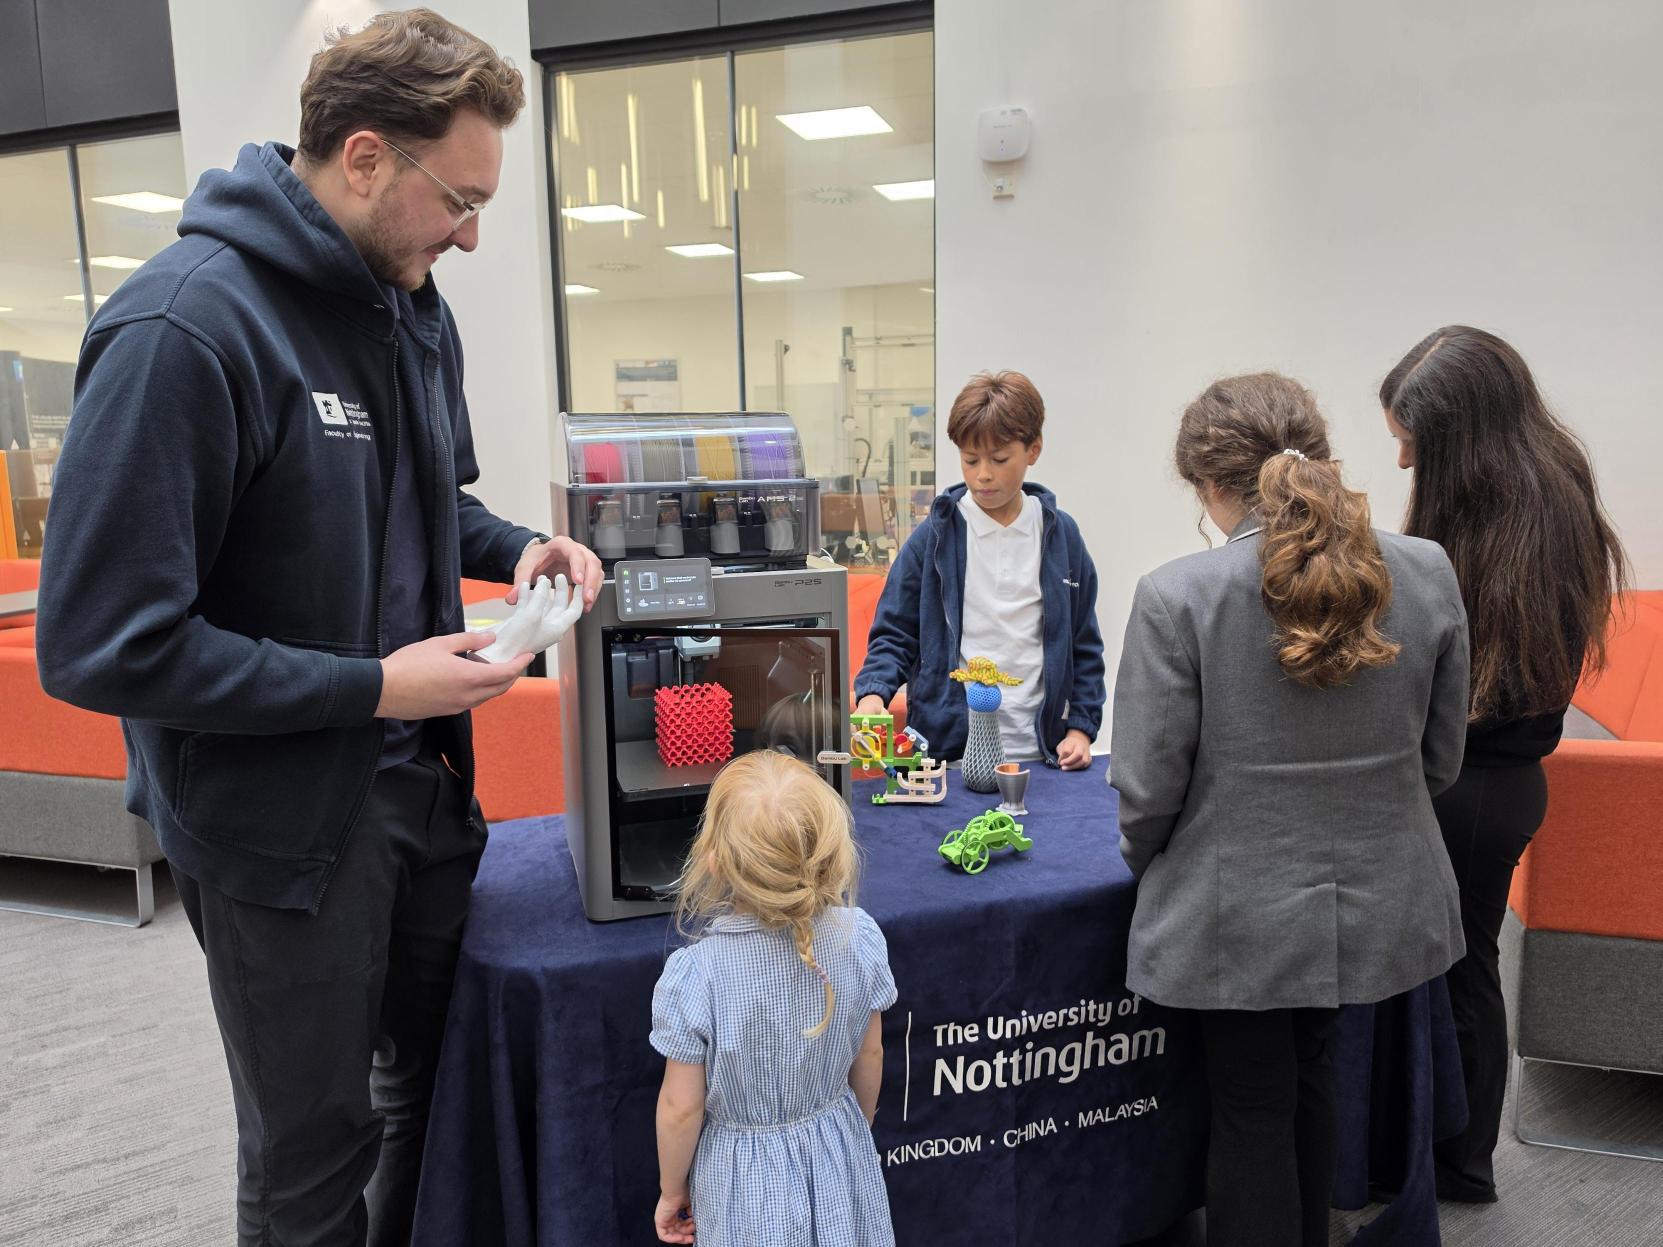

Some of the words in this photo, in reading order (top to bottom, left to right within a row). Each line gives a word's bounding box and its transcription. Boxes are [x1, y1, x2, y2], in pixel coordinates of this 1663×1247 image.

[933, 1022, 979, 1047] The
[987, 998, 1112, 1041] University
[1117, 993, 1143, 1017] of
[933, 1026, 1166, 1096] Nottingham
[887, 1134, 982, 1167] KINGDOM
[1003, 1117, 1058, 1148] CHINA
[1078, 1095, 1159, 1129] MALAYSIA
